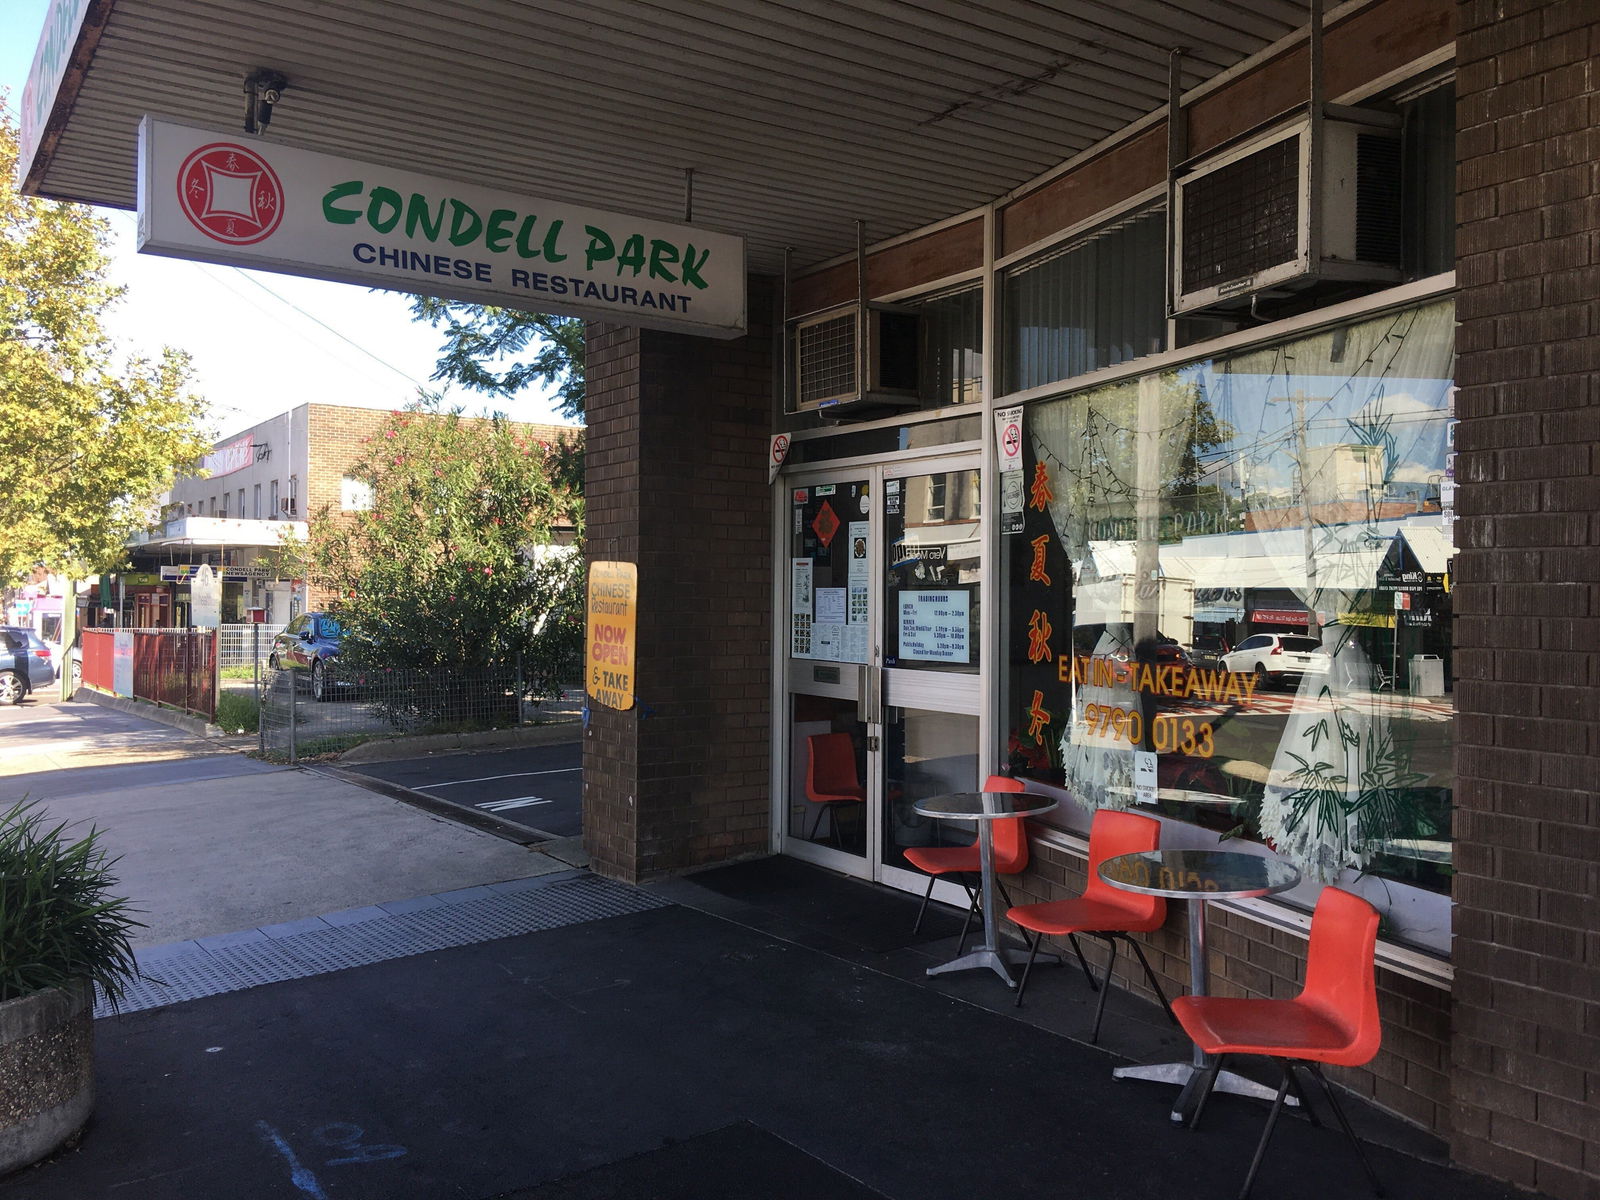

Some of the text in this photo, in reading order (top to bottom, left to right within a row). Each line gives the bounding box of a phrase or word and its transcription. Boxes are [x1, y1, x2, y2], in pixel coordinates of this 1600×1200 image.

[257, 190, 274, 210] 秋
[226, 219, 239, 237] 夏
[322, 181, 710, 290] CONDELL PARK
[353, 243, 692, 313] CHINESE RESTAURANT
[591, 583, 630, 599] CHINESE
[594, 623, 627, 644] NOW
[592, 642, 628, 666] OPEN
[602, 671, 628, 691] TAKE
[1058, 654, 1090, 685] EAT
[1093, 658, 1113, 688] IN
[1129, 662, 1261, 706] TAKEAWAY
[595, 689, 624, 709] AWAY
[1085, 703, 1215, 759] 9790 0133
